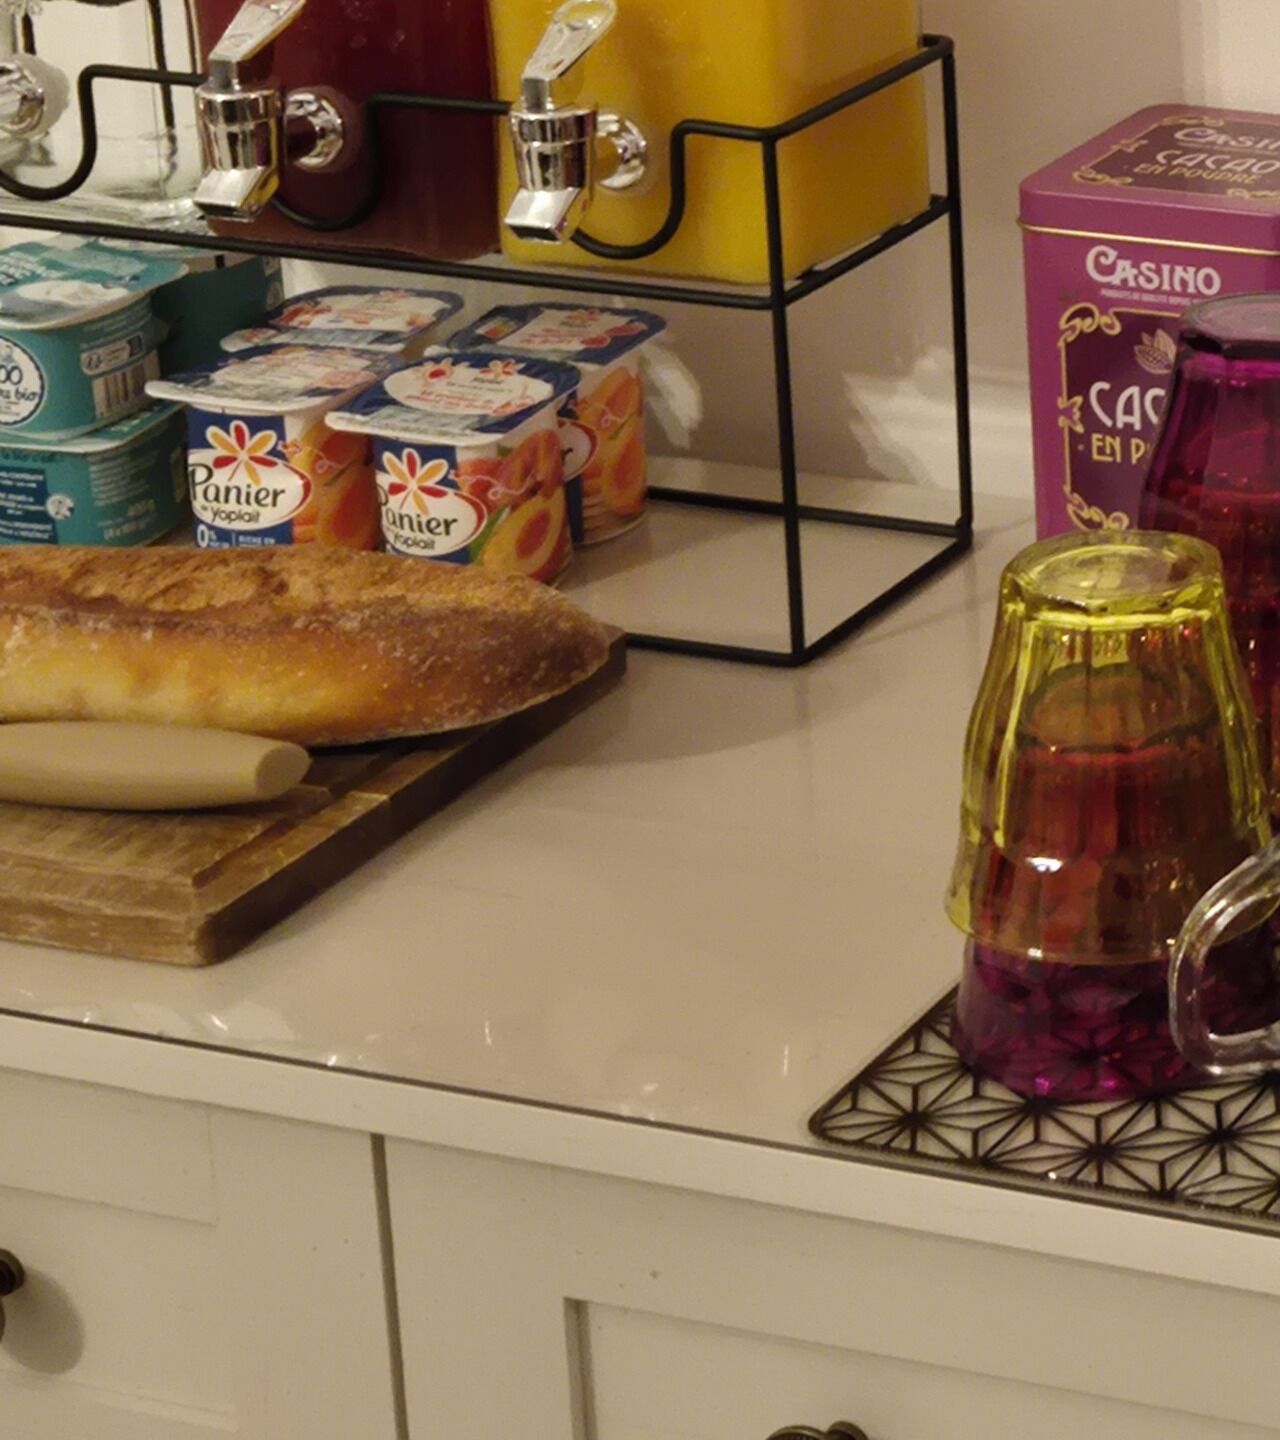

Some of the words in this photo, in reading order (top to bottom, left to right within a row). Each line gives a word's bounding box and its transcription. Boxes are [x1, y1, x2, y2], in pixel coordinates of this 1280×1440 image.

[1133, 162, 1167, 175] EN
[1168, 165, 1264, 185] POUDRE
[1088, 380, 1166, 431] CAC
[1091, 432, 1122, 464] EN
[188, 463, 286, 508] Panier
